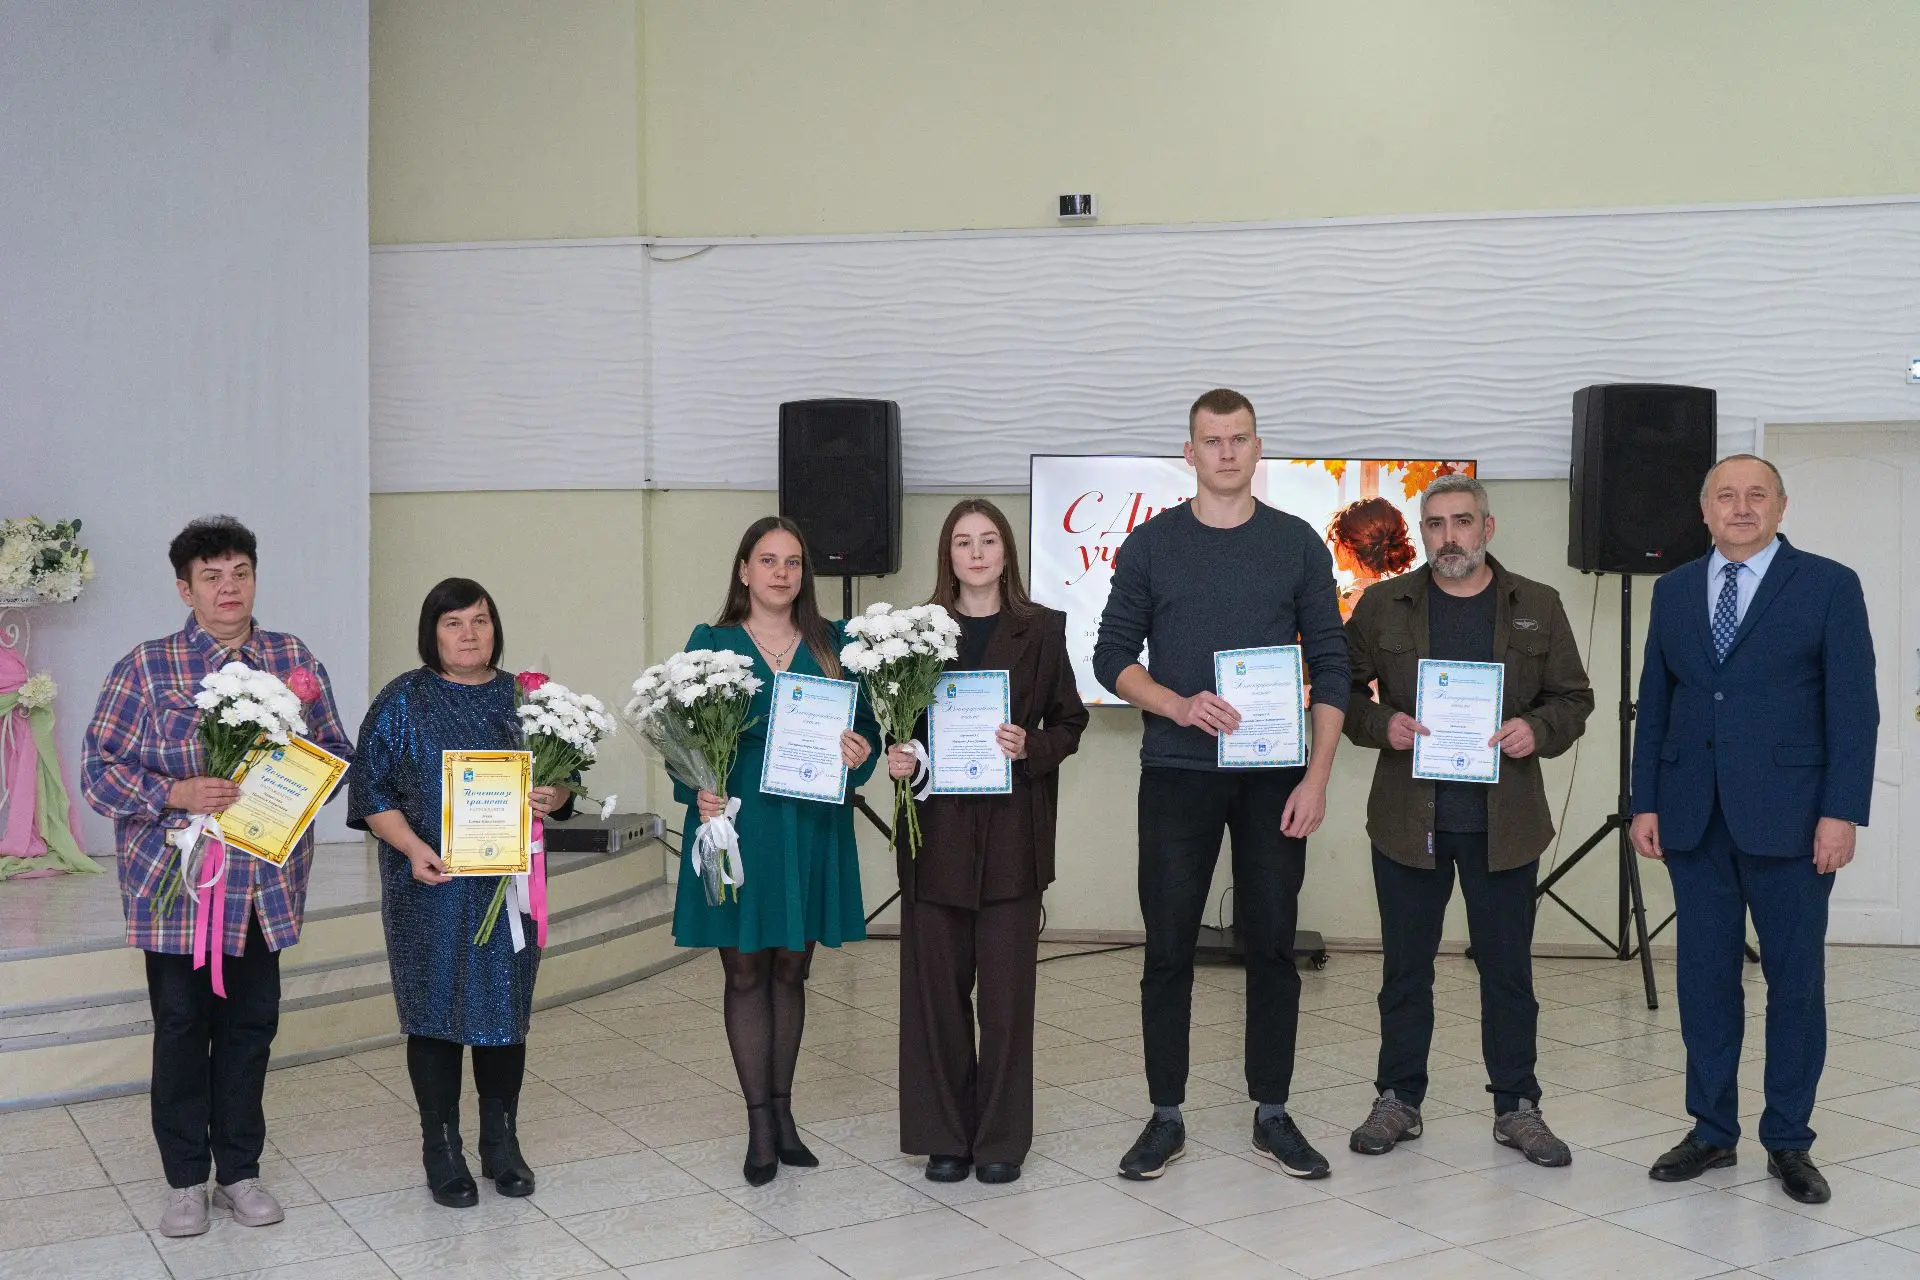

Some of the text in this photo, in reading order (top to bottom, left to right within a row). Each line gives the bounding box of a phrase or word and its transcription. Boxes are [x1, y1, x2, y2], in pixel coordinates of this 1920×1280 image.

[1063, 490, 1104, 534] С
[1065, 545, 1121, 586] уч
[261, 775, 301, 798] грамота
[264, 764, 309, 792] Почетная
[463, 788, 512, 798] Почетная
